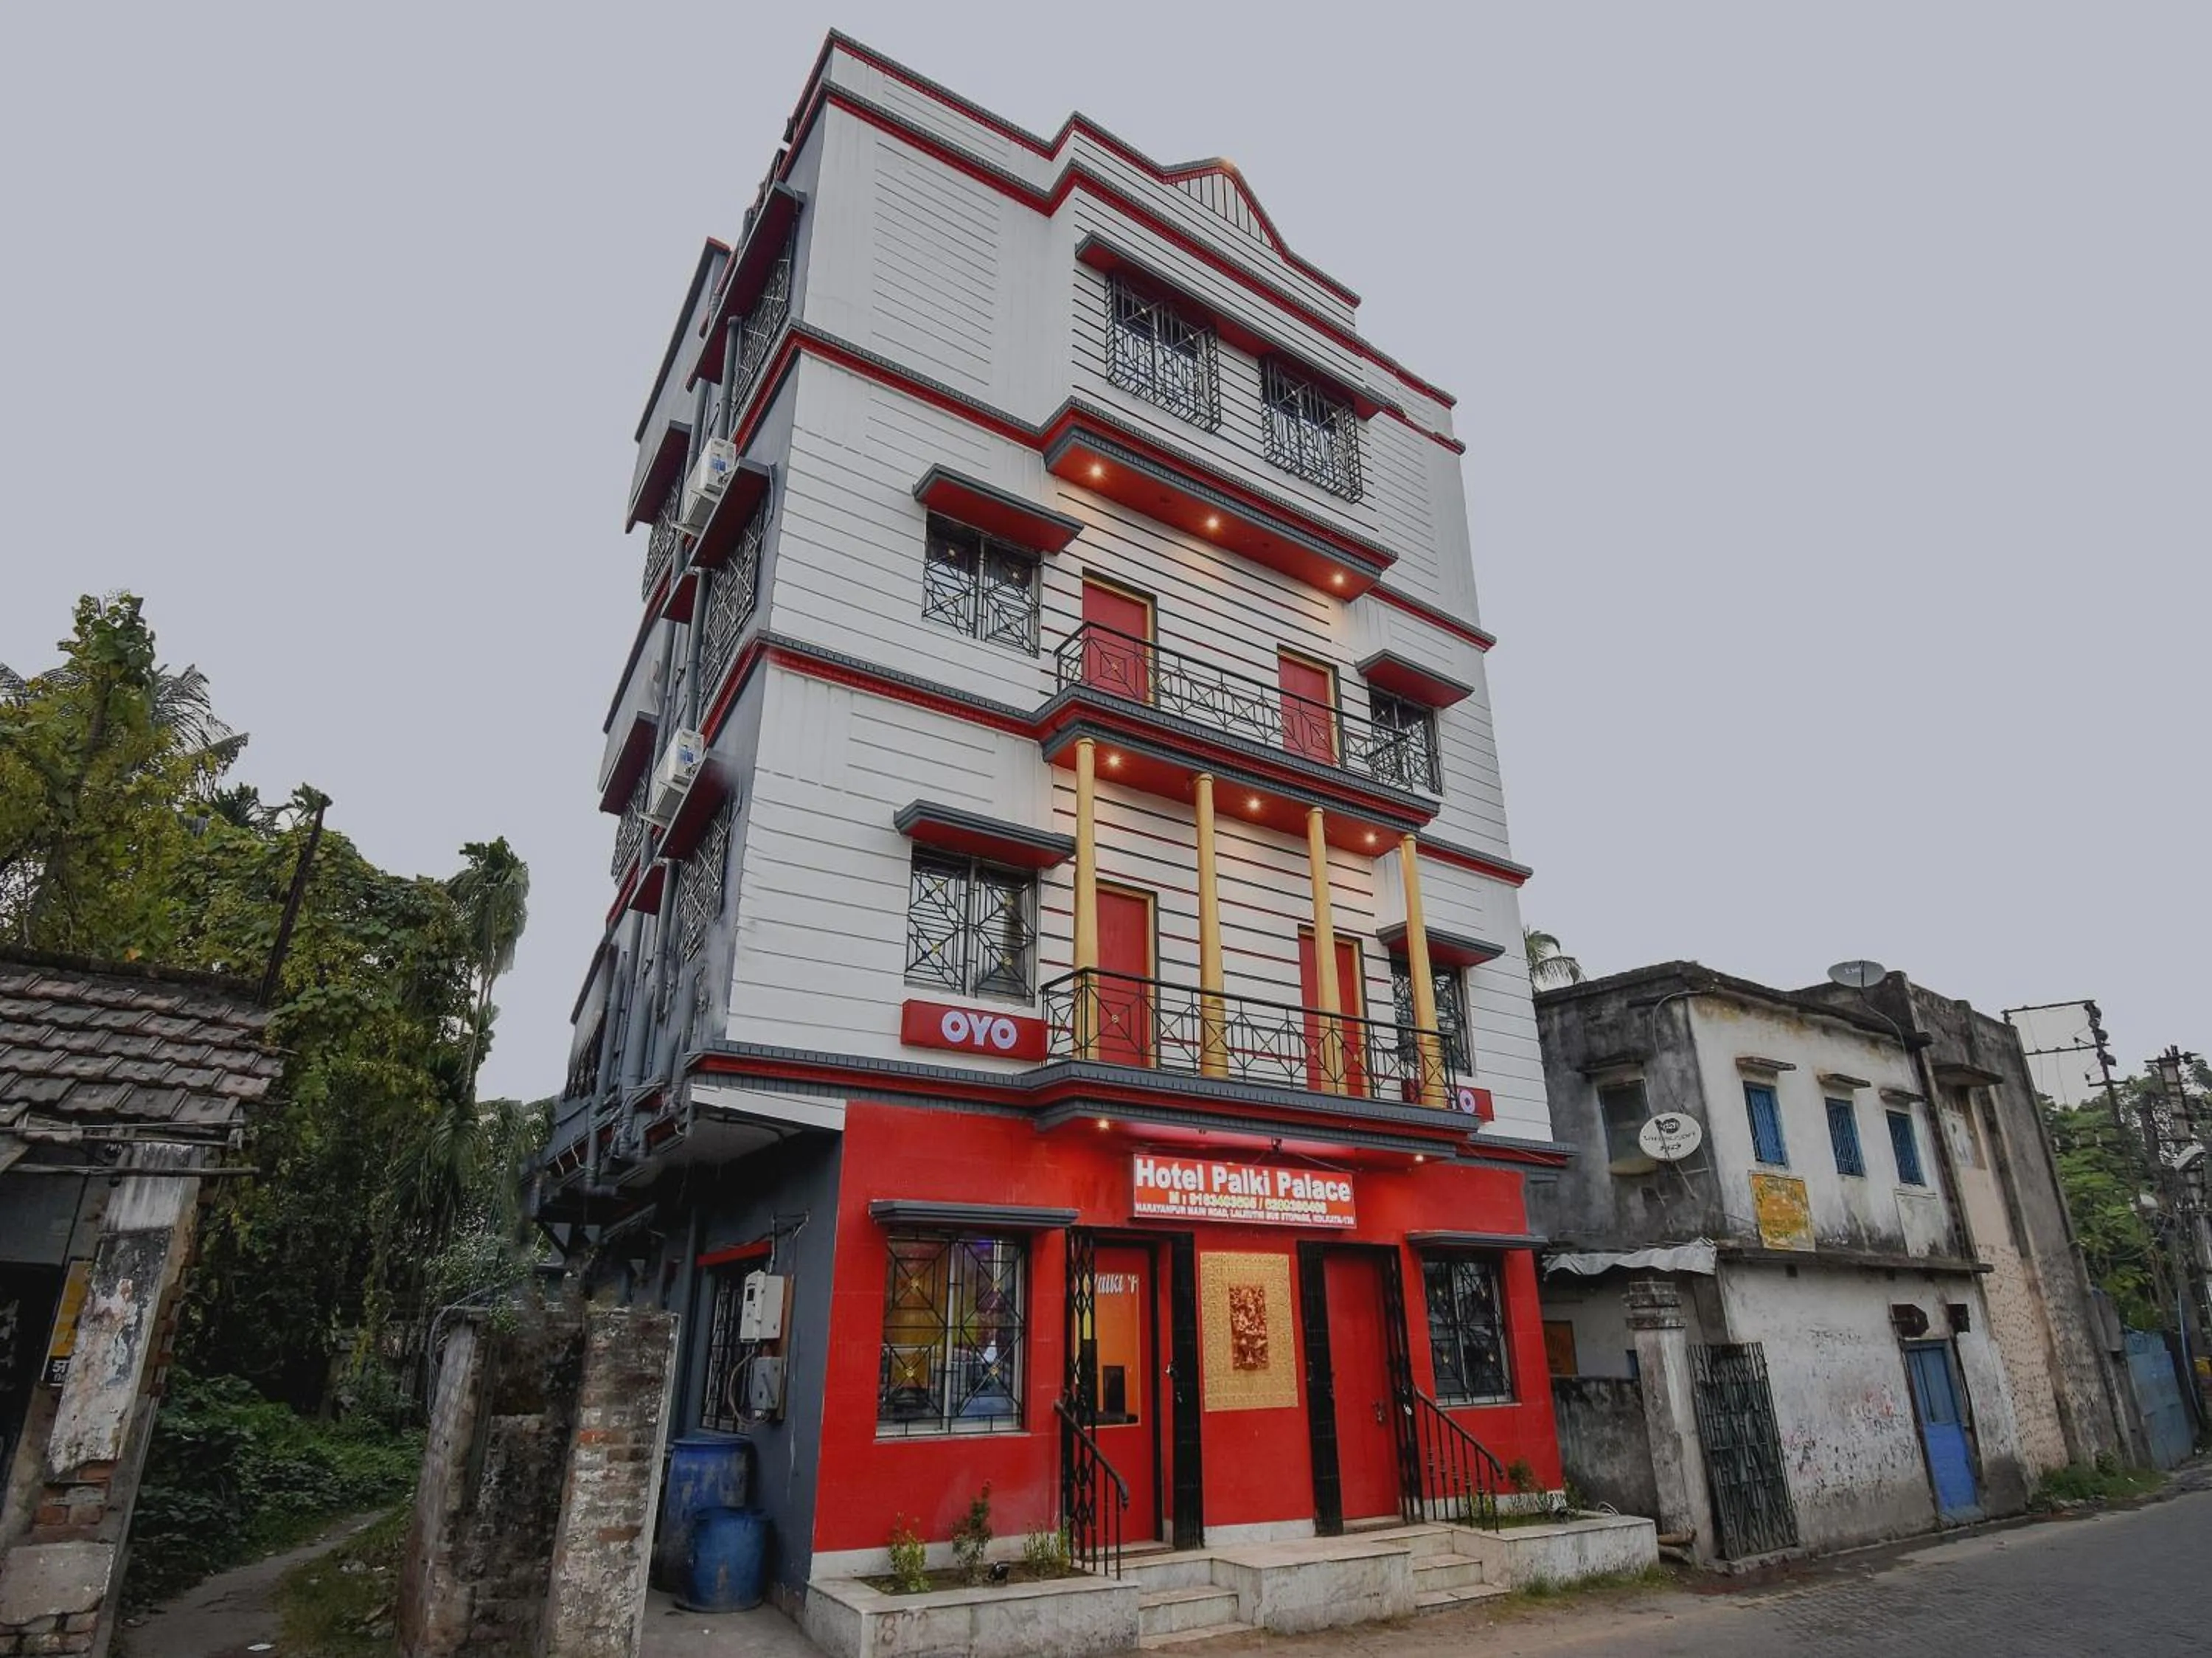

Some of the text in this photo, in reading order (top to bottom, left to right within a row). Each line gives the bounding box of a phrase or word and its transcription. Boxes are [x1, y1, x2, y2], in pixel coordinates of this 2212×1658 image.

[942, 1010, 1018, 1050] OYO
[1136, 1158, 1204, 1191] Hotel
[1213, 1166, 1270, 1195] Palki
[1277, 1171, 1351, 1201] Palace
